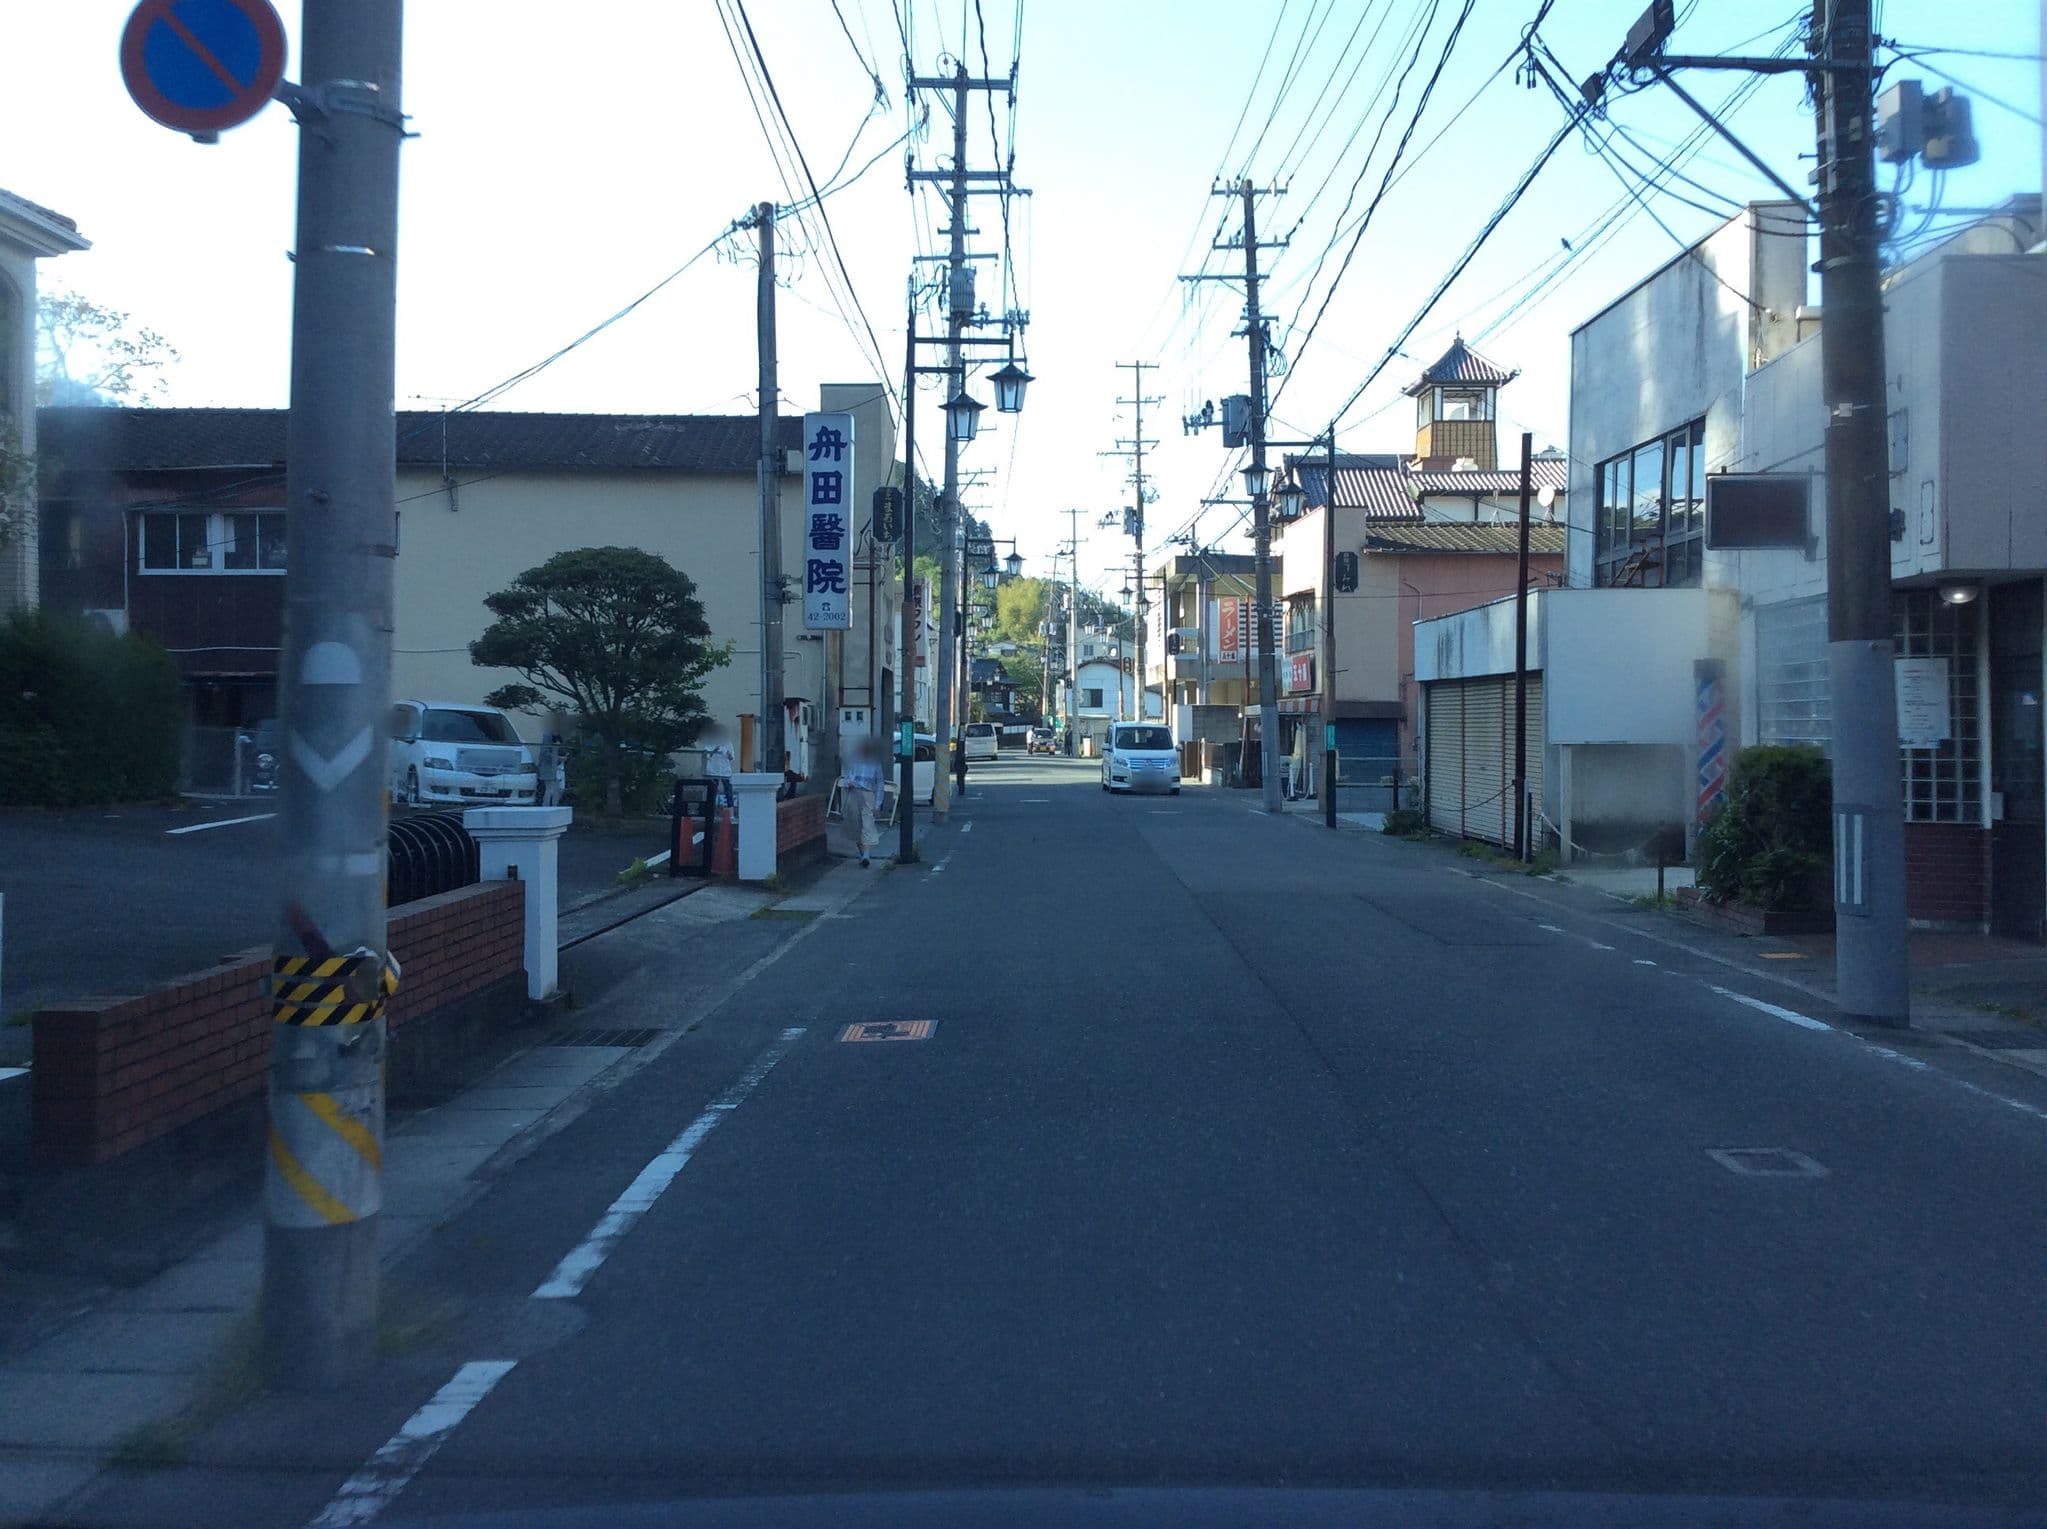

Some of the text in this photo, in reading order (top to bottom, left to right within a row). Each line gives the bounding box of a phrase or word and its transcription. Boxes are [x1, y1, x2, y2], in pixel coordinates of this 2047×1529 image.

[807, 425, 848, 595] 舟田醫院
[1221, 601, 1236, 650] ラーメン
